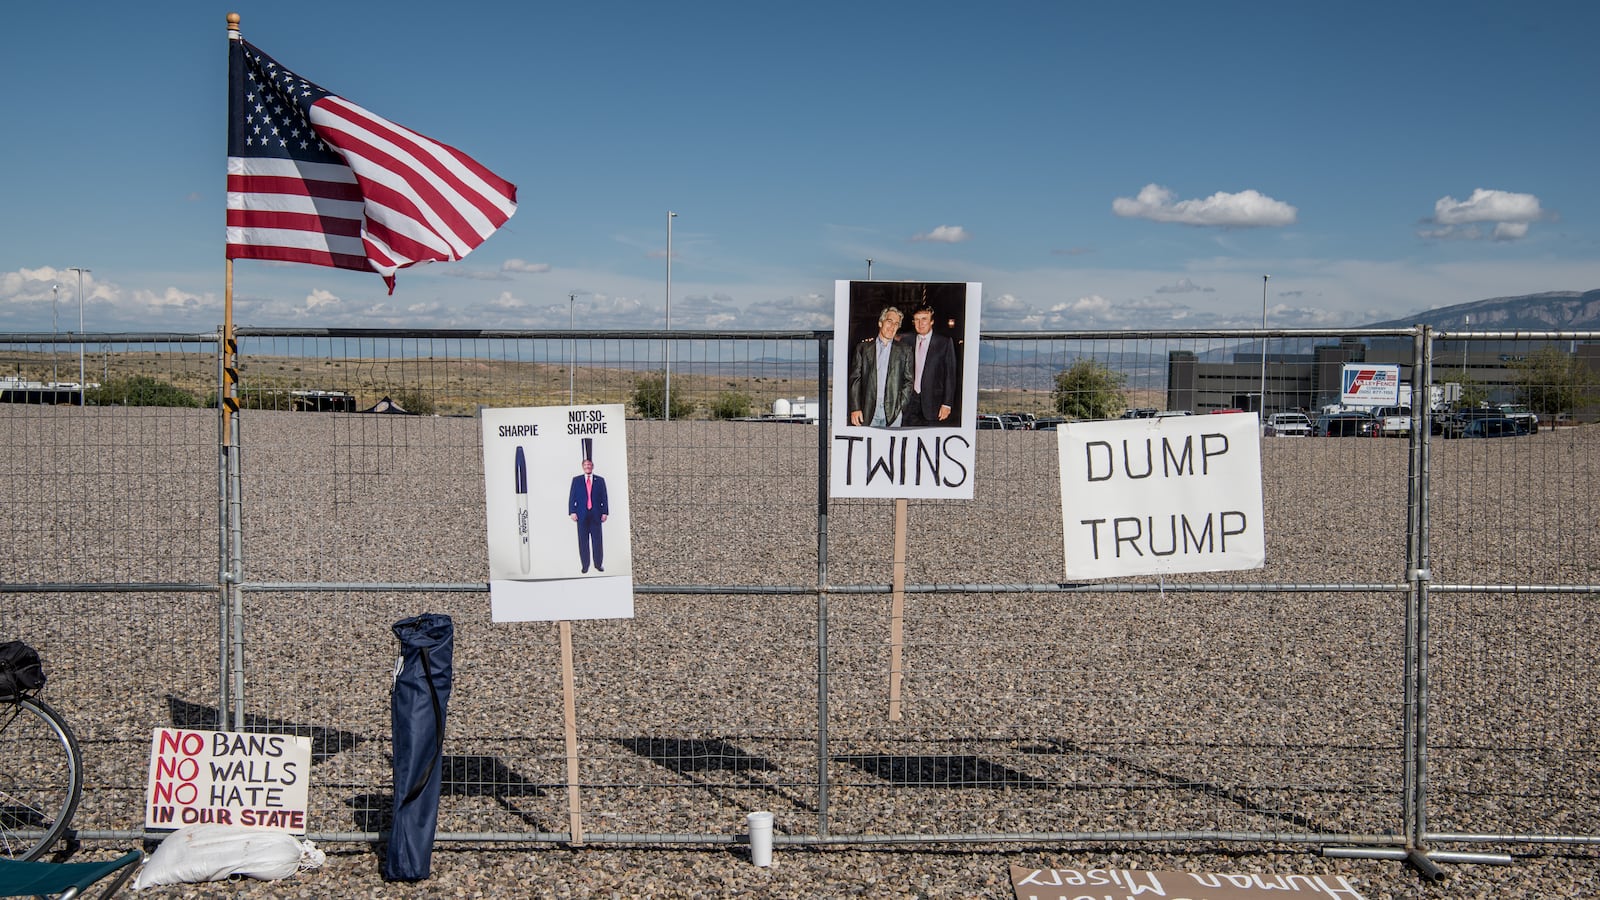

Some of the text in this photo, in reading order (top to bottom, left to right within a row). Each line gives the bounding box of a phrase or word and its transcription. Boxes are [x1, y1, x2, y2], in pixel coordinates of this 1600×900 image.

[567, 422, 608, 435] SHARPIE
[568, 410, 605, 422] NOT-SO-
[499, 424, 539, 437] SHARPIE
[835, 435, 970, 488] TWINS
[1086, 433, 1229, 482] DUMP
[1081, 511, 1247, 560] TRUMP
[159, 730, 285, 758] NO BANS
[156, 756, 297, 785] NO WALLS
[153, 782, 283, 807] NO HATE
[152, 806, 304, 829] IN OUR STATE
[1017, 869, 1365, 900] Human Misery
